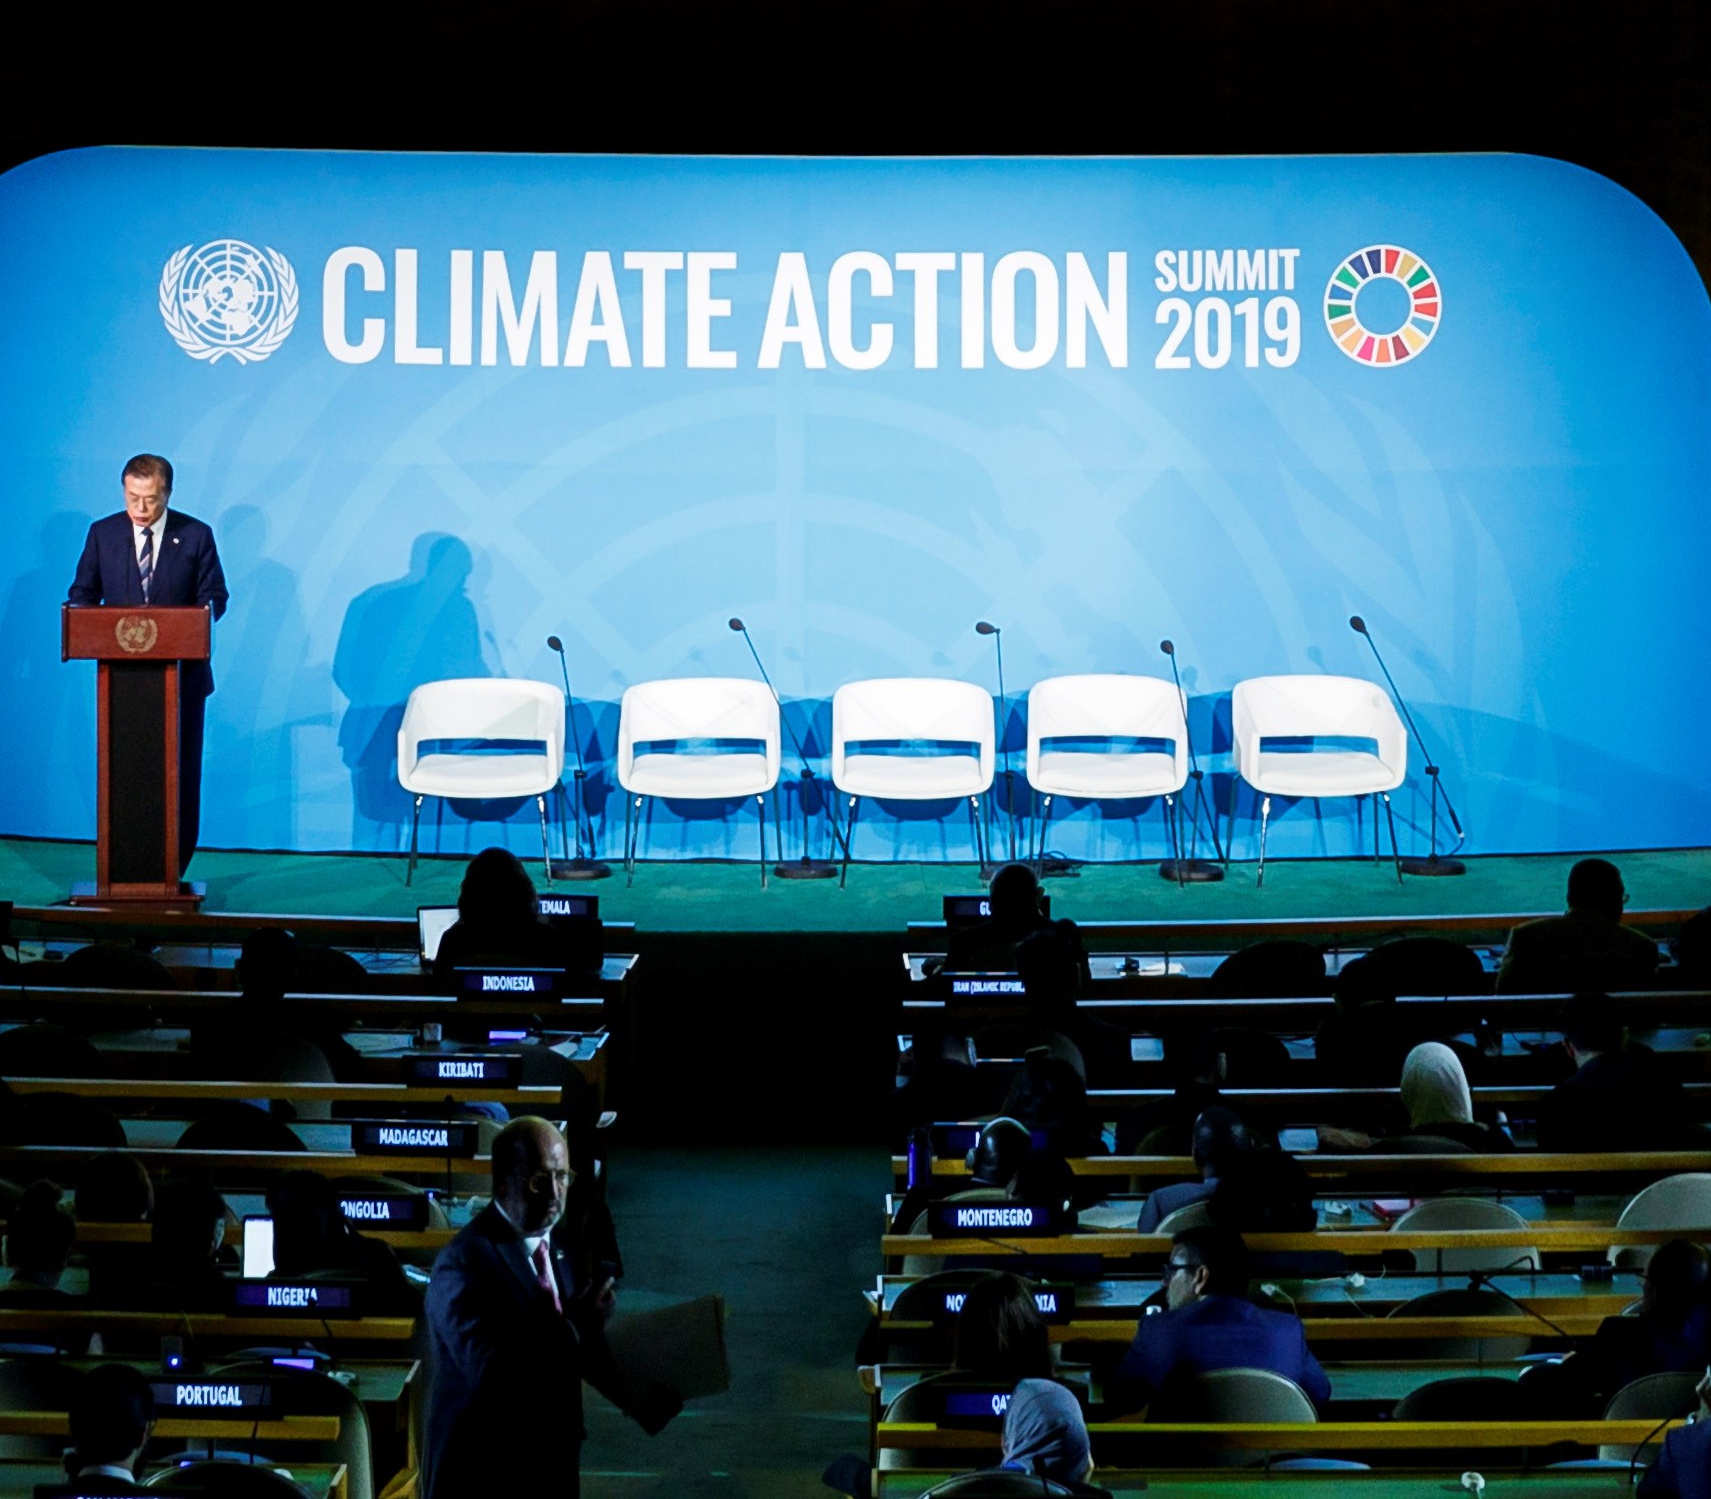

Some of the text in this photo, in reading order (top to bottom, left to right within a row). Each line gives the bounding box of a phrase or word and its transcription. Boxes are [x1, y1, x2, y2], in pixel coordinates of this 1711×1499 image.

[1153, 248, 1301, 293] SUMMIT
[322, 246, 1128, 371] CLIMATE ACTION
[1154, 296, 1301, 370] 2019
[482, 975, 535, 991] INDONESIA
[438, 1061, 485, 1079] KIRIBATI
[379, 1128, 449, 1147] MADAGASCAR
[341, 1201, 390, 1220] ONGOLIA
[957, 1208, 1033, 1227] MONTENEGRO
[176, 1385, 243, 1407] PORTUGAL
